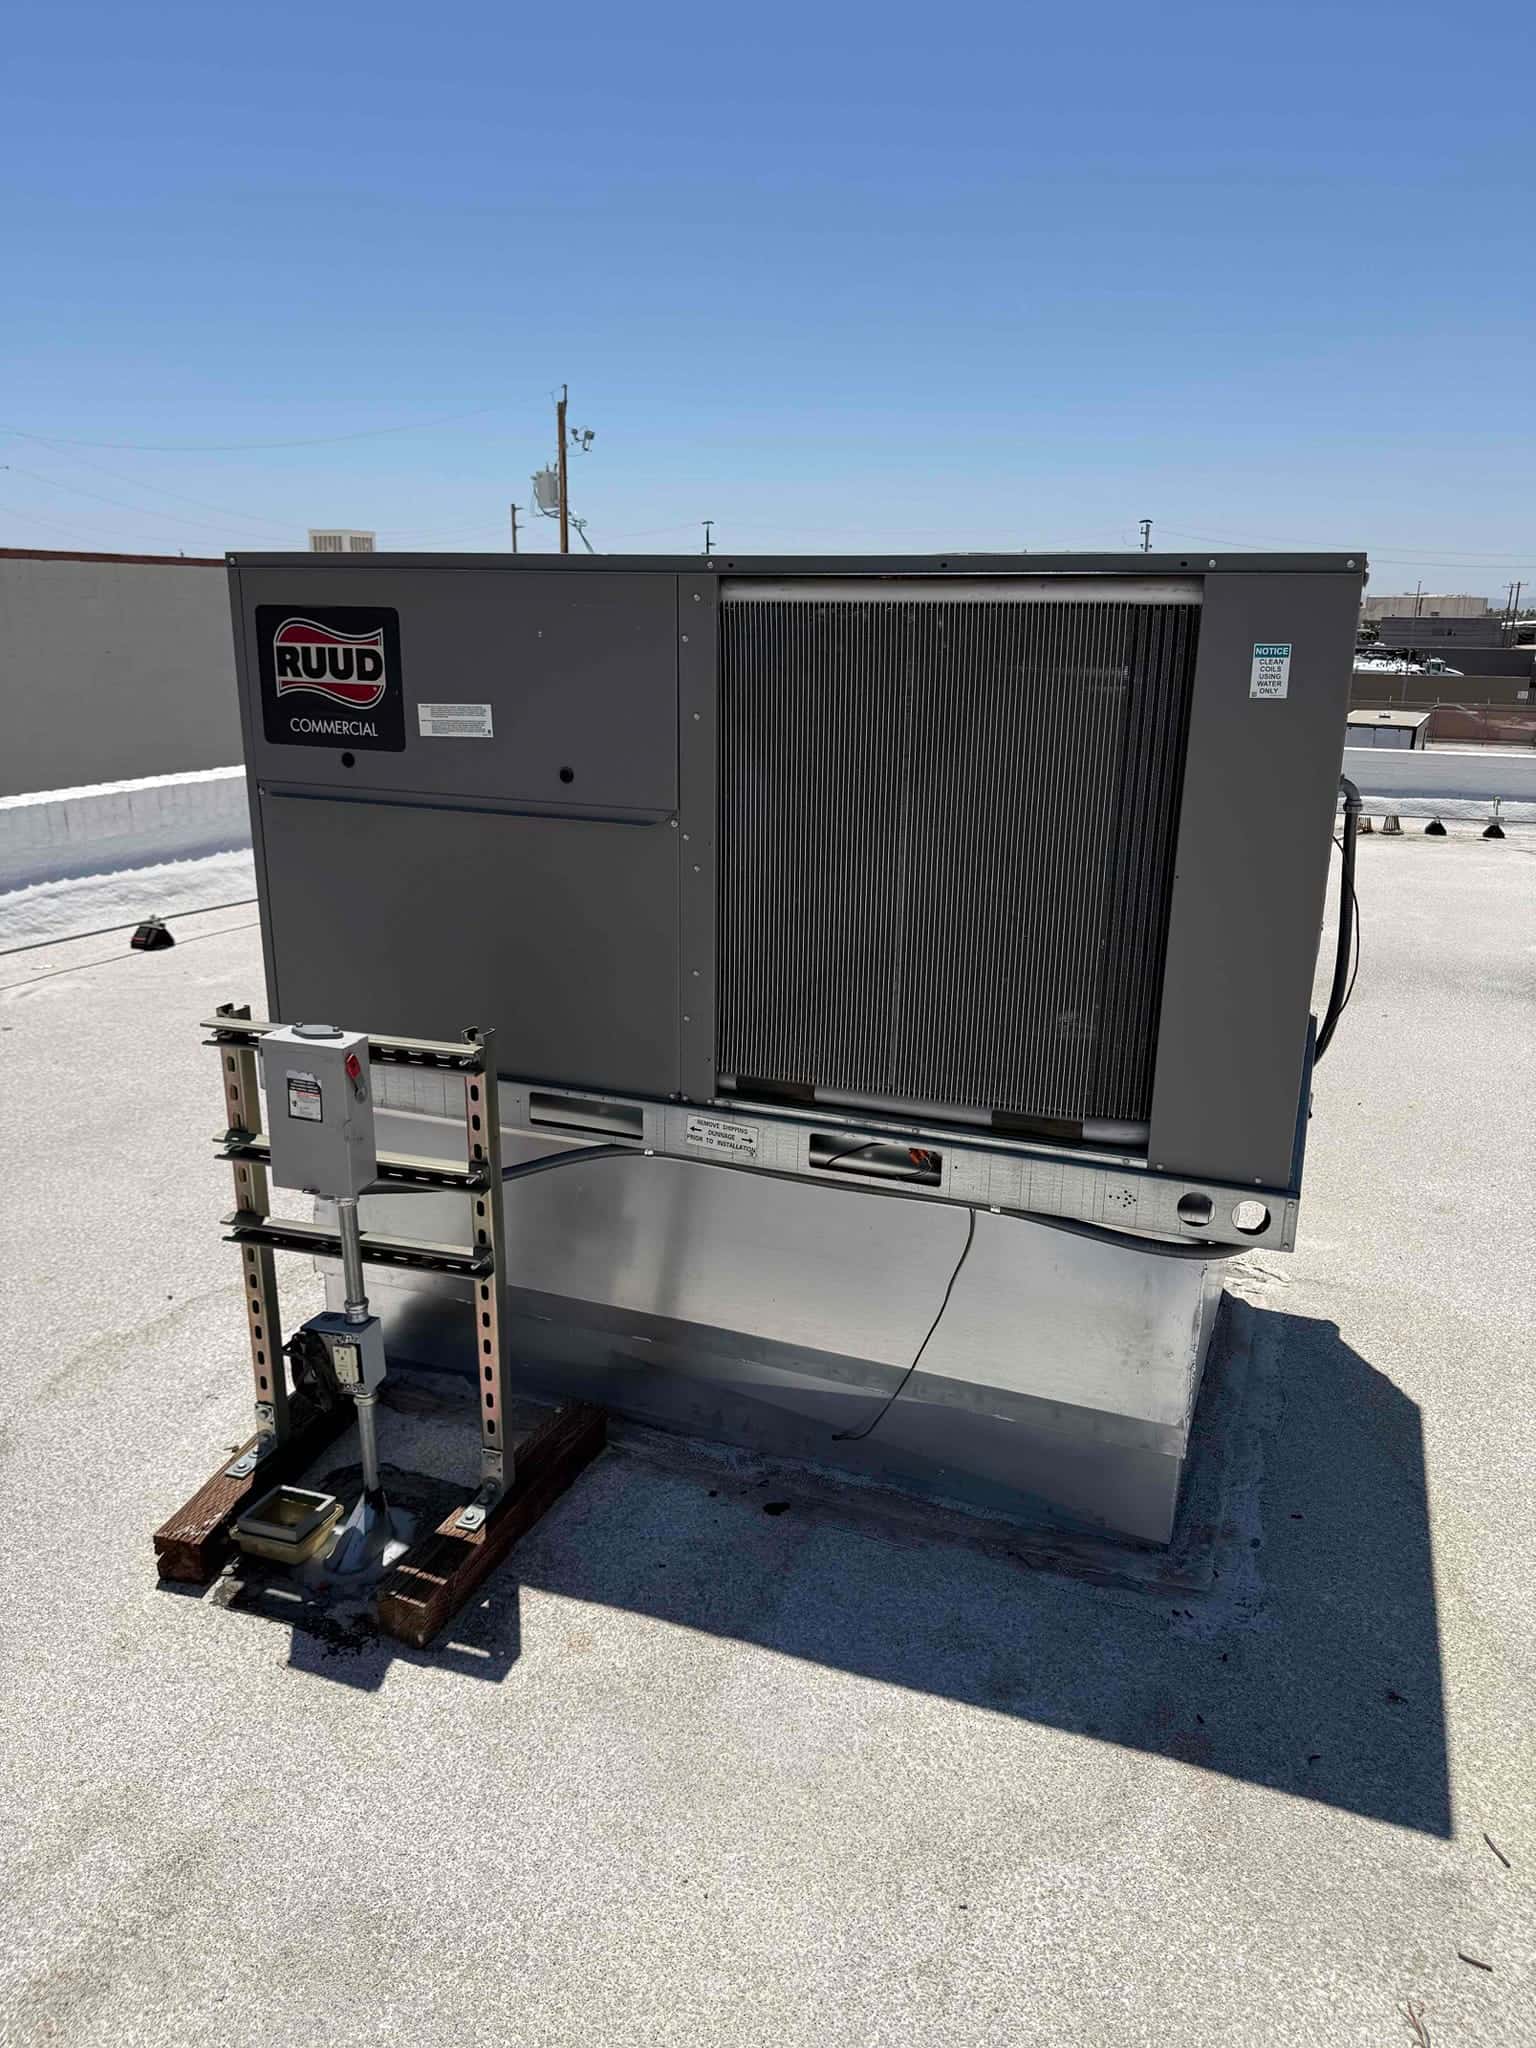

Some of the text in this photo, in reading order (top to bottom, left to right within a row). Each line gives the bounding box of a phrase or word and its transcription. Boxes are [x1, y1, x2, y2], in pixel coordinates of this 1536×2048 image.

[1255, 647, 1289, 656] NOTICE
[276, 646, 383, 681] RUUD
[290, 718, 379, 737] COMMERCIAL
[697, 1119, 749, 1135] REMOVE SHIPPING
[687, 1133, 756, 1153] PRIOR TO INSTALLATION
